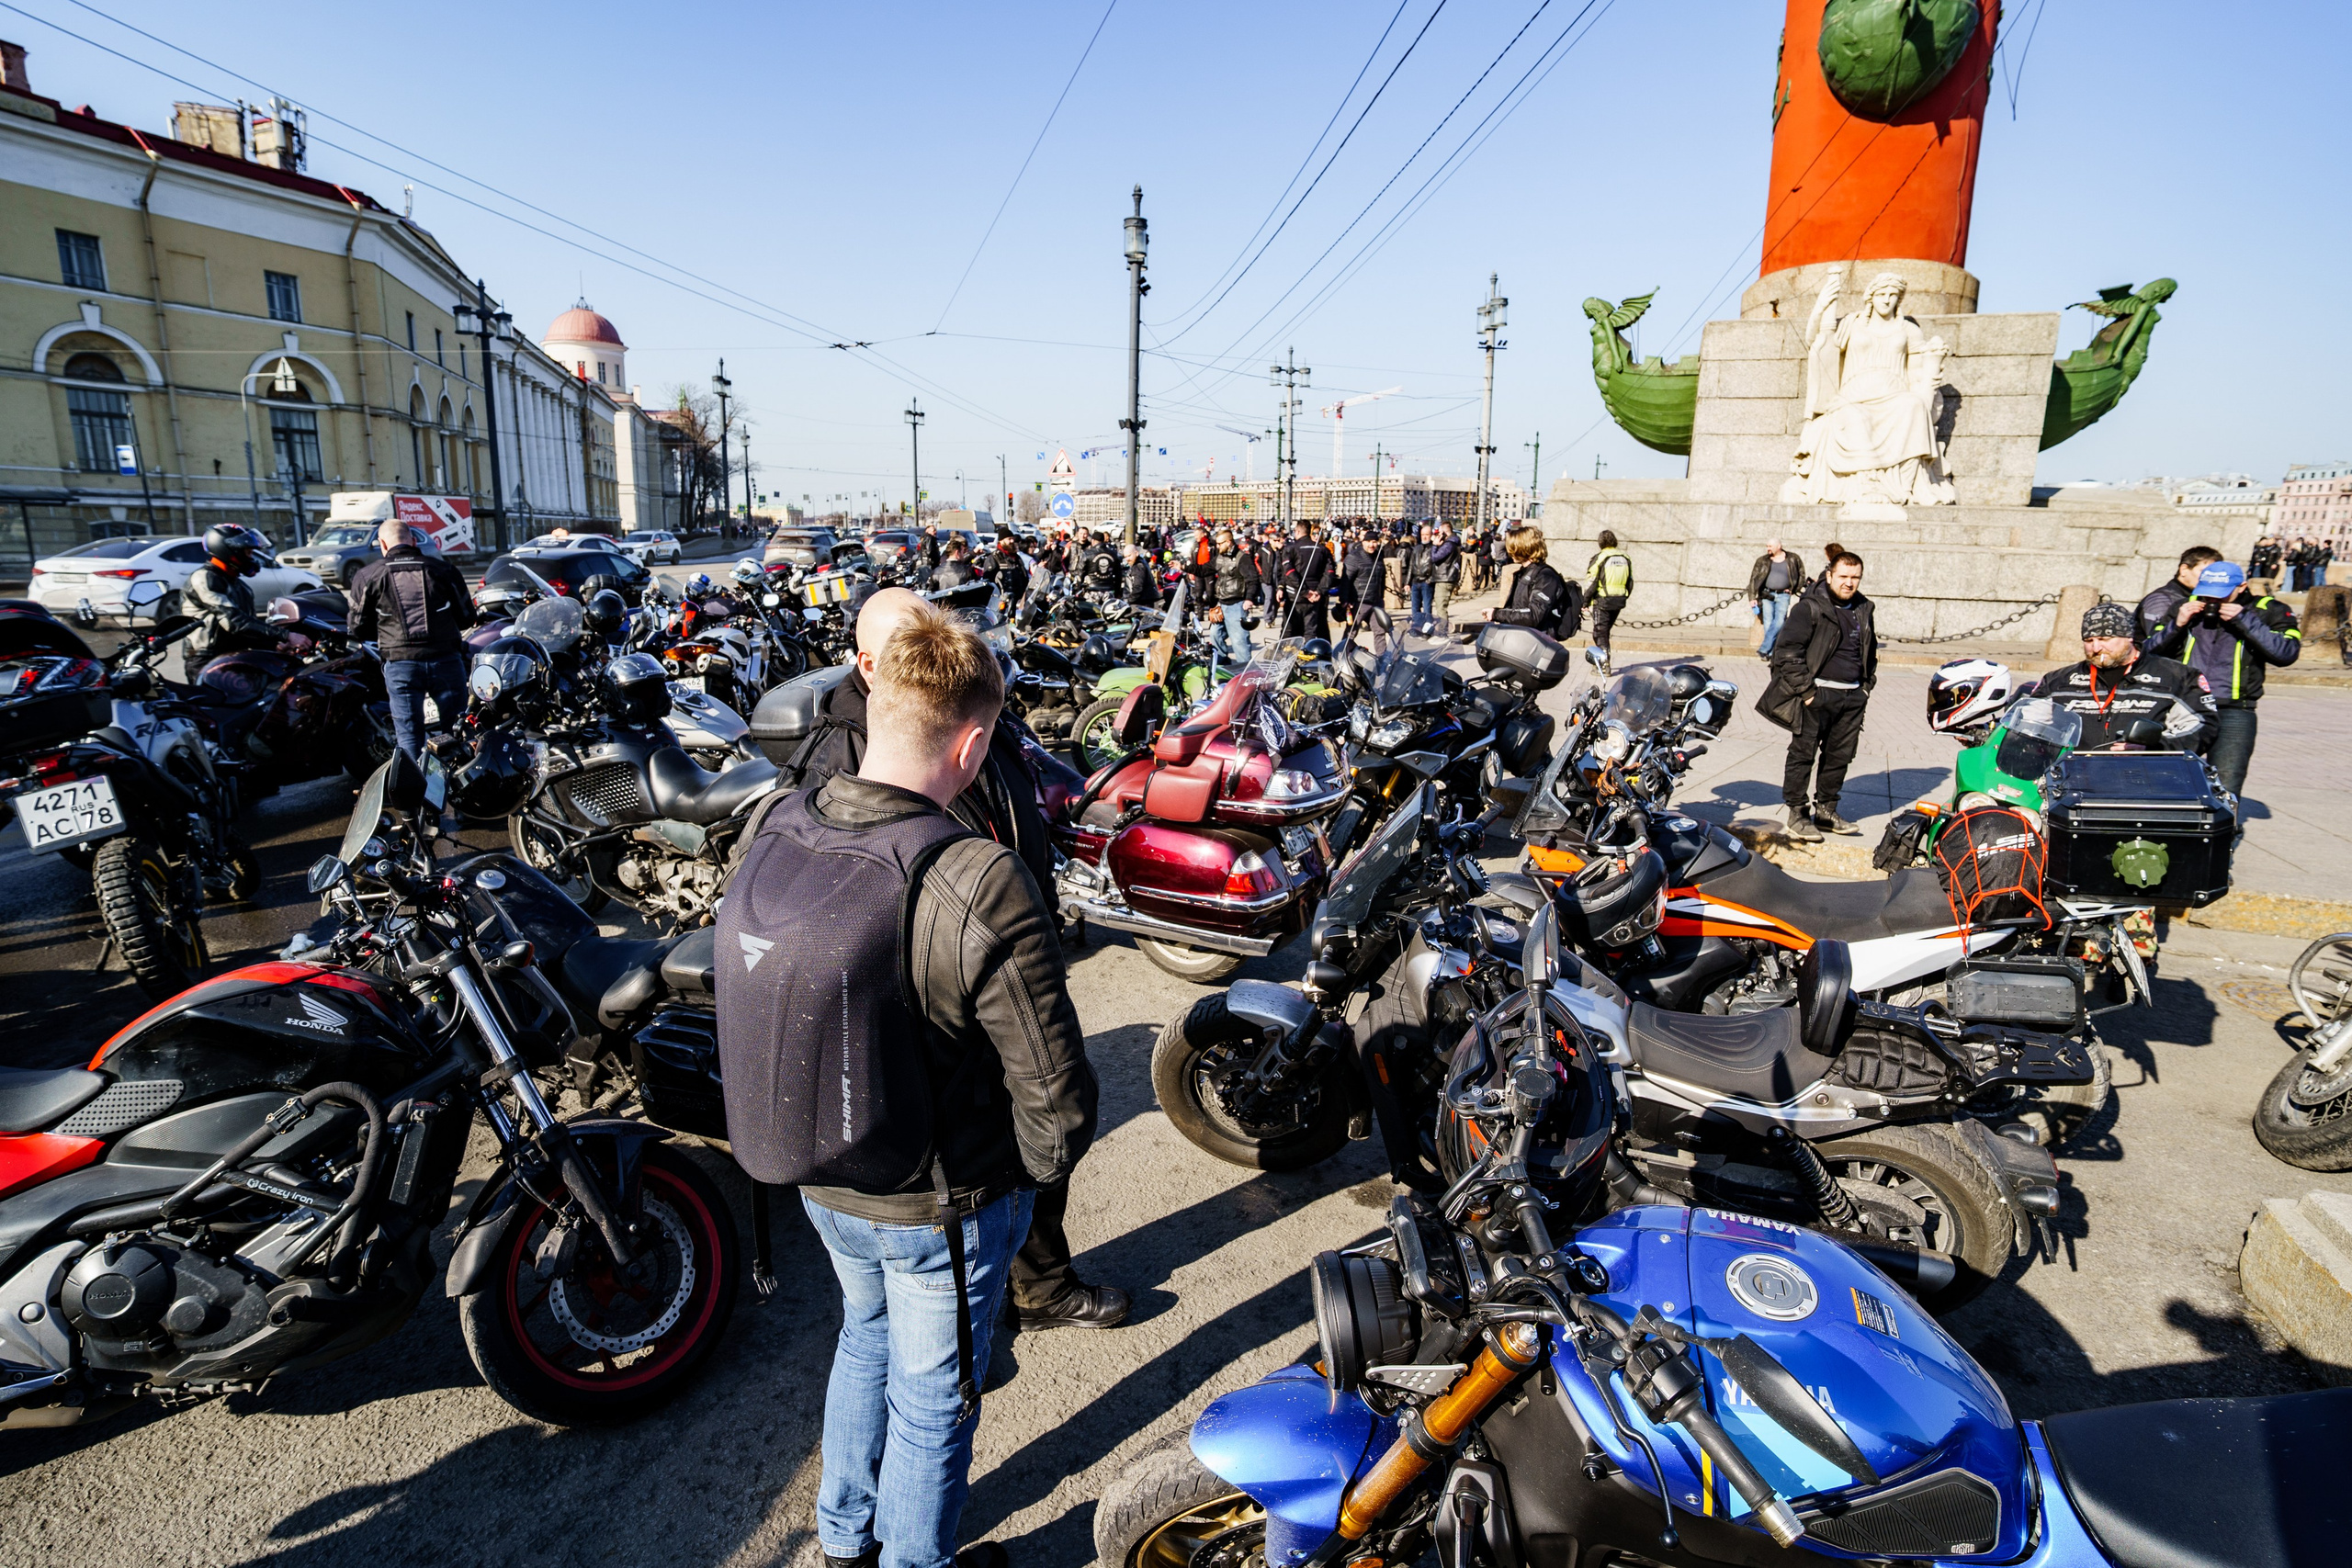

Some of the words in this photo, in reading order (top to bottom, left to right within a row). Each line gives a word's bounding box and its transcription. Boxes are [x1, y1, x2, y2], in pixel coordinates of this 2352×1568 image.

[399, 501, 424, 513] Яндекс
[400, 512, 433, 523] Доставка
[33, 783, 97, 814] 4271
[71, 801, 95, 812] RUS
[37, 818, 74, 842] AC
[80, 807, 113, 829] 78
[285, 1017, 345, 1036] HONDA
[842, 1074, 852, 1143] SHIMA
[258, 1182, 290, 1199] Crazy
[291, 1191, 314, 1205] Iron
[1706, 1208, 1802, 1236] YAMAHA
